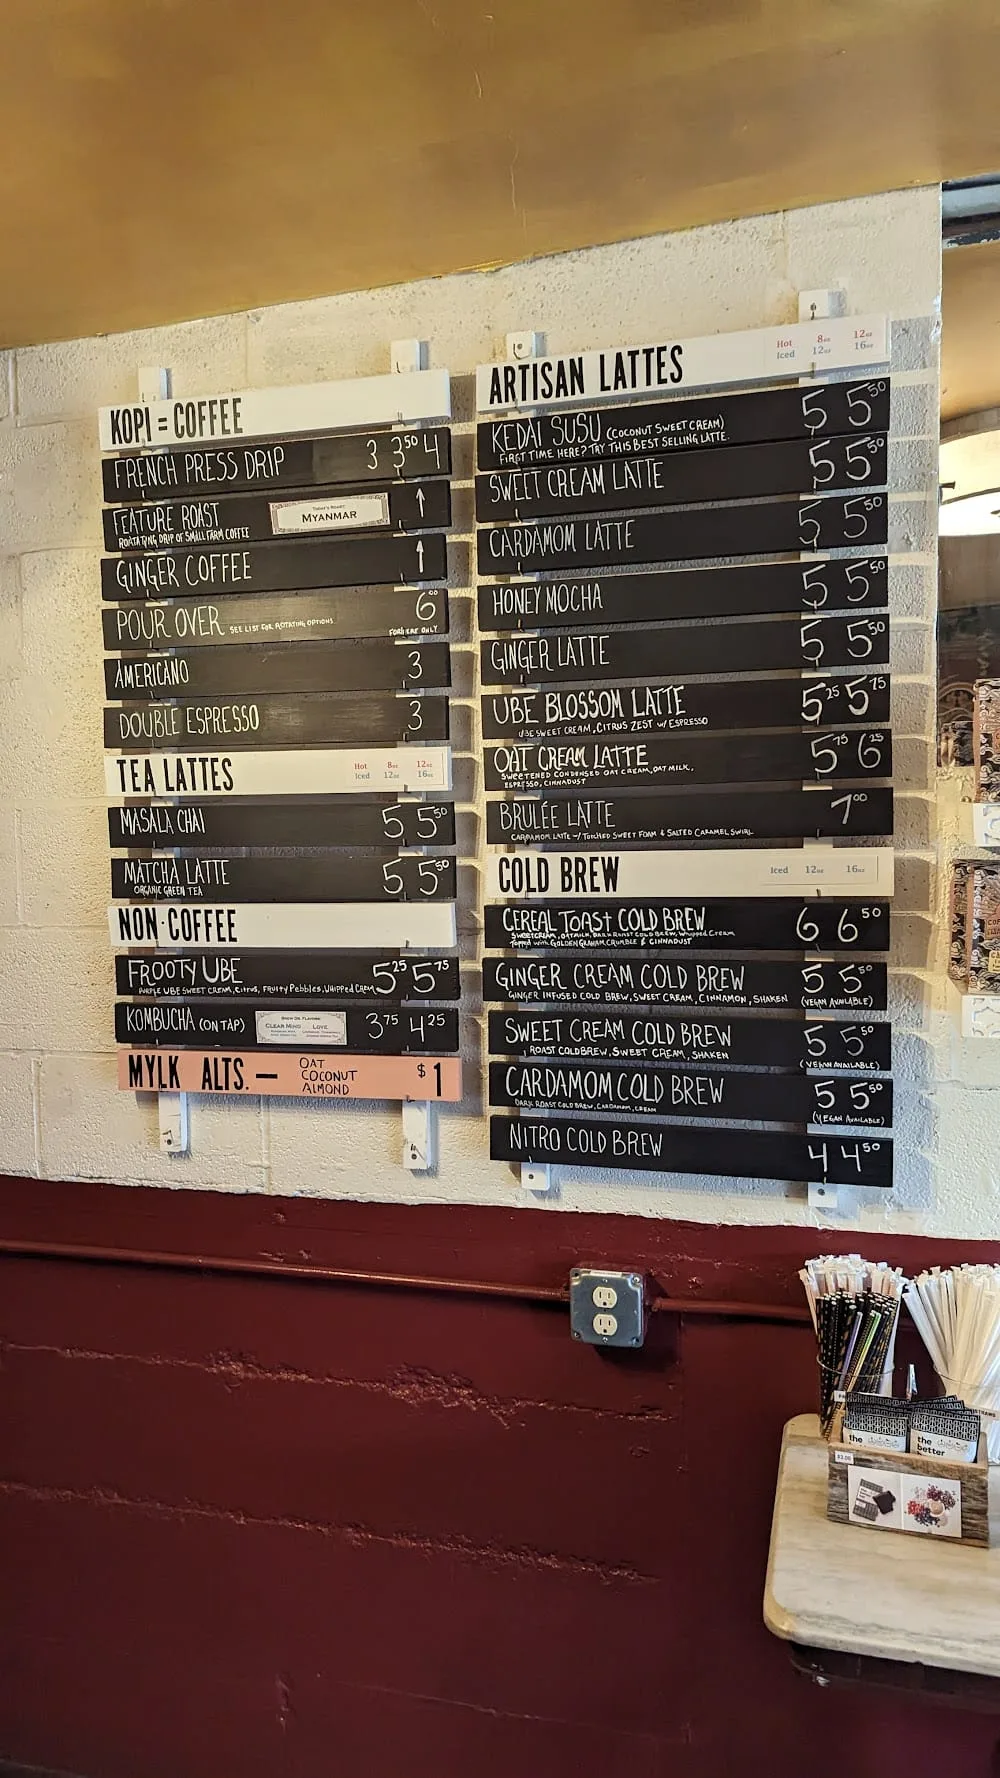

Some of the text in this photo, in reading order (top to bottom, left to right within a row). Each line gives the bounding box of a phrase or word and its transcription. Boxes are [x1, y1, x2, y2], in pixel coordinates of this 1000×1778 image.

[489, 345, 683, 404] ARTISAN LATTES
[110, 407, 152, 444] KOPI
[174, 398, 243, 438] COFFEE
[492, 417, 542, 452] KEDAI
[551, 412, 601, 445] SUSU
[366, 440, 378, 469] 3
[424, 434, 440, 469] 4
[528, 449, 554, 460] TIME
[557, 445, 587, 459] HERE?
[588, 443, 606, 455] TRY
[608, 440, 631, 453] THIS
[633, 438, 660, 451] BEST
[662, 434, 699, 448] SELLING
[114, 447, 284, 489] FRENCH PRESS DRIP
[490, 458, 664, 503] SWEET CREAM LATTE
[113, 503, 219, 535] FEATURE ROAST
[489, 519, 635, 558] CARDAMOM LATTE
[116, 552, 252, 593] GINGER COFFEE
[493, 583, 603, 616] HONEY MOCHA
[117, 606, 225, 640] POUR OVER
[230, 625, 243, 634] SEE
[244, 625, 260, 633] LIST
[275, 620, 306, 630] ROTATING
[306, 617, 334, 626] OPTIONS
[407, 651, 422, 679] 3
[491, 635, 610, 674] GINGER LATTE
[114, 659, 189, 689] AMERICANO
[407, 701, 423, 731] 3
[493, 685, 686, 724] UBE BLOSSOM LATTE
[119, 704, 260, 739] DOUBLE ESPRESSO
[535, 728, 561, 737] SWEET
[631, 719, 653, 731] ZEST
[669, 717, 708, 728] ESPRESSO
[494, 744, 648, 773] OAT CREAM LATTE
[116, 757, 234, 792] TEA LATTES
[120, 807, 206, 836] MASALA CHAI
[382, 804, 404, 838] 5
[499, 800, 616, 831] BRULÉE LATTE
[125, 858, 230, 886] MATCHA LATTE
[383, 858, 404, 894] 5
[498, 856, 620, 893] COLD BREW
[163, 885, 185, 897] GREEN
[188, 884, 203, 897] TEA
[502, 907, 558, 932] CEREAL
[618, 907, 658, 932] COLD
[663, 906, 705, 931] BREW
[796, 907, 820, 941] 6
[202, 956, 243, 984] UBE
[495, 962, 745, 992] GINGER CREAM COLD BREW
[801, 963, 824, 994] 5
[164, 986, 180, 995] UBE
[182, 987, 206, 995] SWEET
[508, 991, 540, 1001] GINGER
[543, 991, 578, 1001] INFUSED
[580, 992, 600, 1001] COLD
[633, 992, 661, 1002] SWEET
[753, 994, 789, 1004] SHAKEN
[126, 1006, 196, 1032] KOMBUCHA
[504, 1018, 731, 1047] SWEET CREAM COLD BREW
[530, 1045, 556, 1056] ROAST
[612, 1046, 648, 1057] SWEET
[692, 1050, 729, 1060] SHAKEN
[803, 1025, 827, 1057] 5
[128, 1055, 250, 1091] MYLK ALTS.
[300, 1057, 325, 1069] OAT
[301, 1069, 358, 1082] COCONUT
[302, 1082, 350, 1095] ALMOND
[505, 1066, 725, 1105] CARDAMOM COLD BREW
[814, 1080, 835, 1109] 5
[509, 1123, 663, 1158] NITRO COLD BREW
[808, 1143, 828, 1173] 4
[917, 1436, 932, 1445] the
[917, 1444, 946, 1457] better
